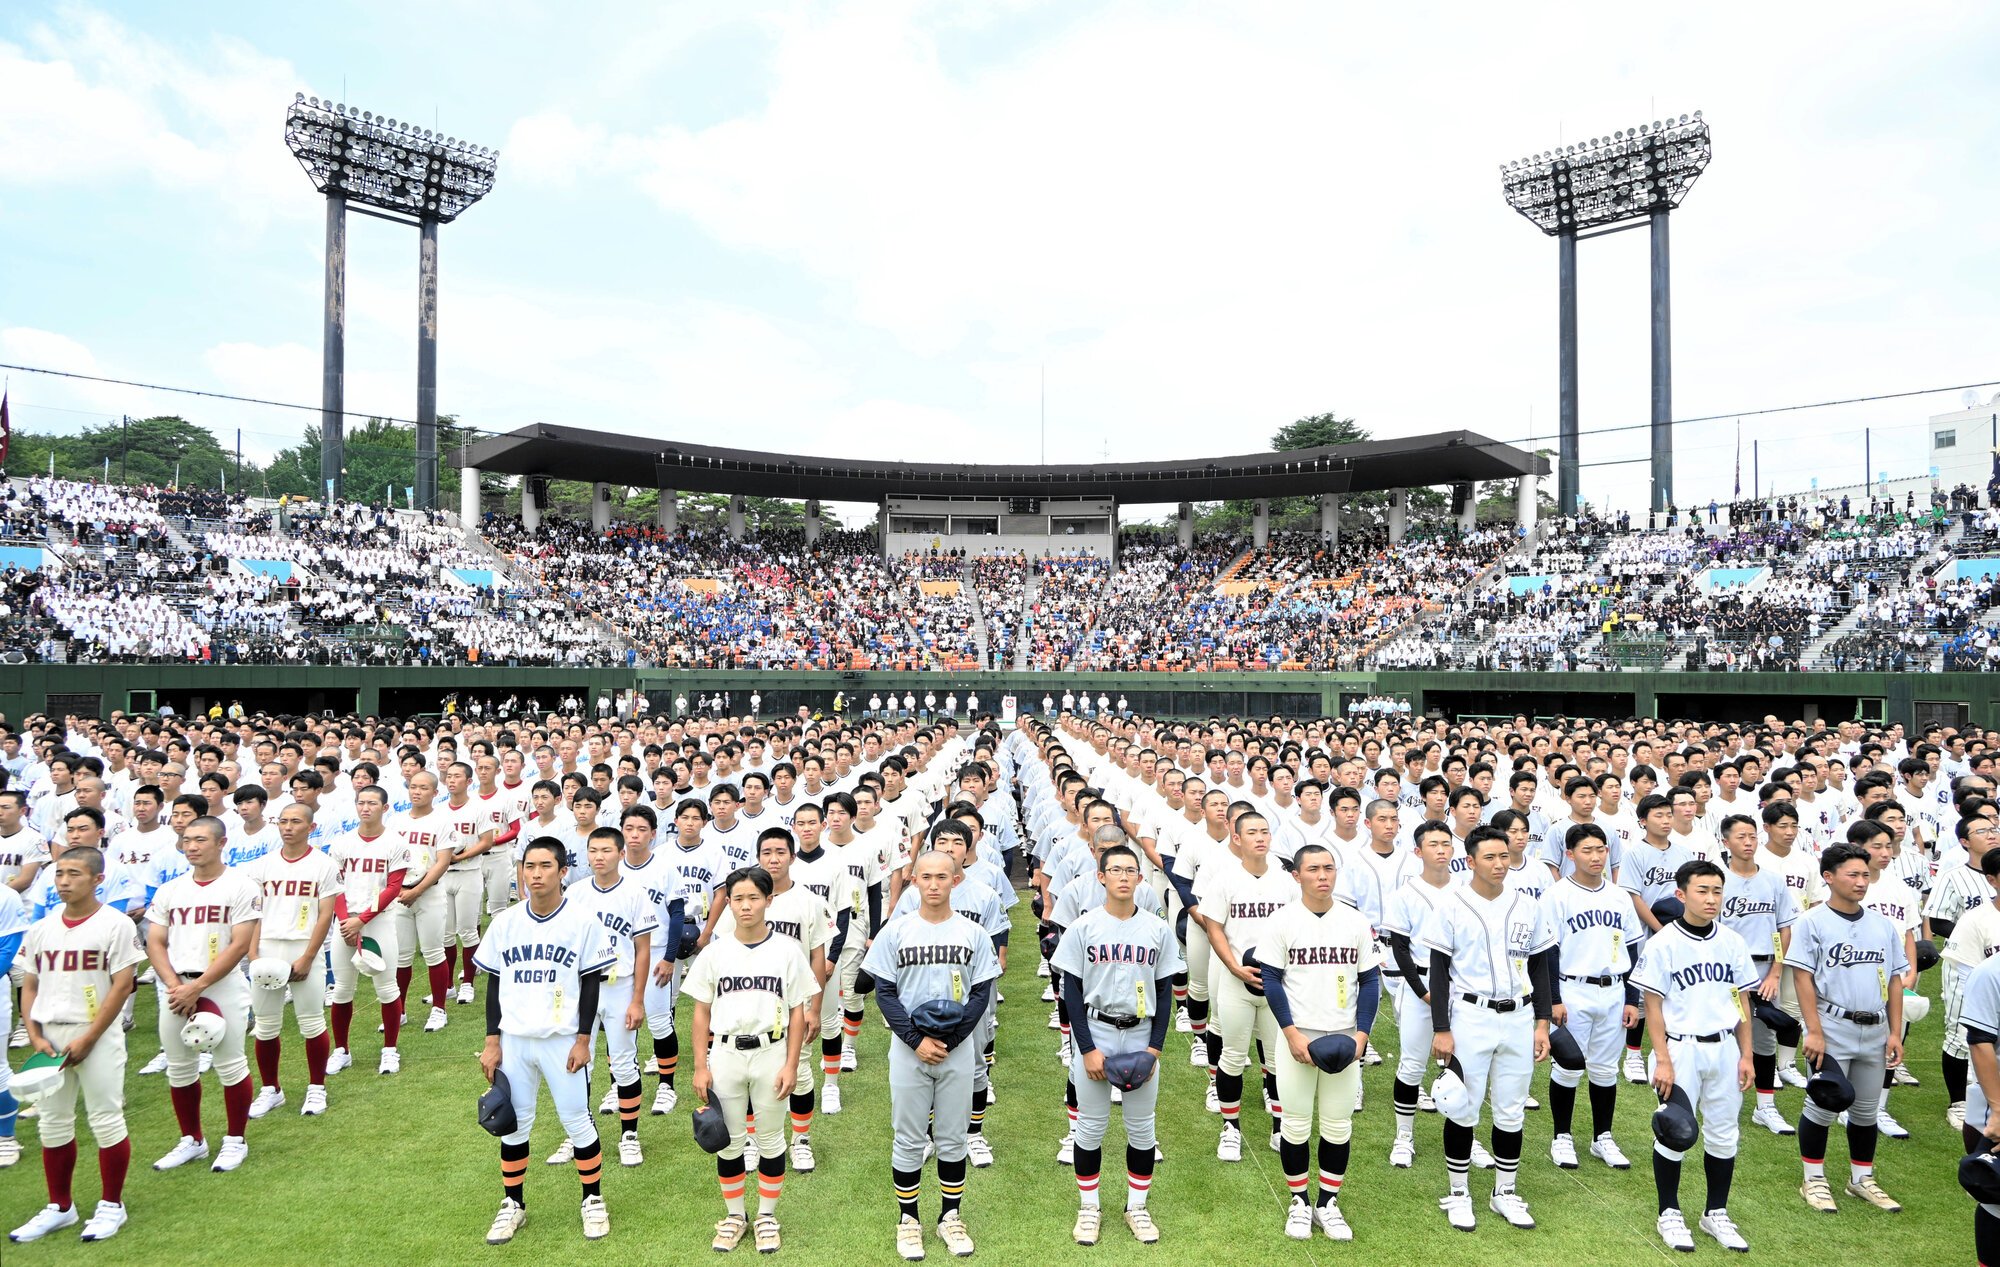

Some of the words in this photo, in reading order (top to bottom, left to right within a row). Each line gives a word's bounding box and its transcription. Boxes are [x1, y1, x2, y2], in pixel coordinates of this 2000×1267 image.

[1644, 866, 1677, 887] Izu
[502, 943, 577, 969] KAWAGOE
[1086, 943, 1156, 966] SAKADO
[1825, 943, 1885, 968] Izumi
[513, 969, 557, 984] KOGYO
